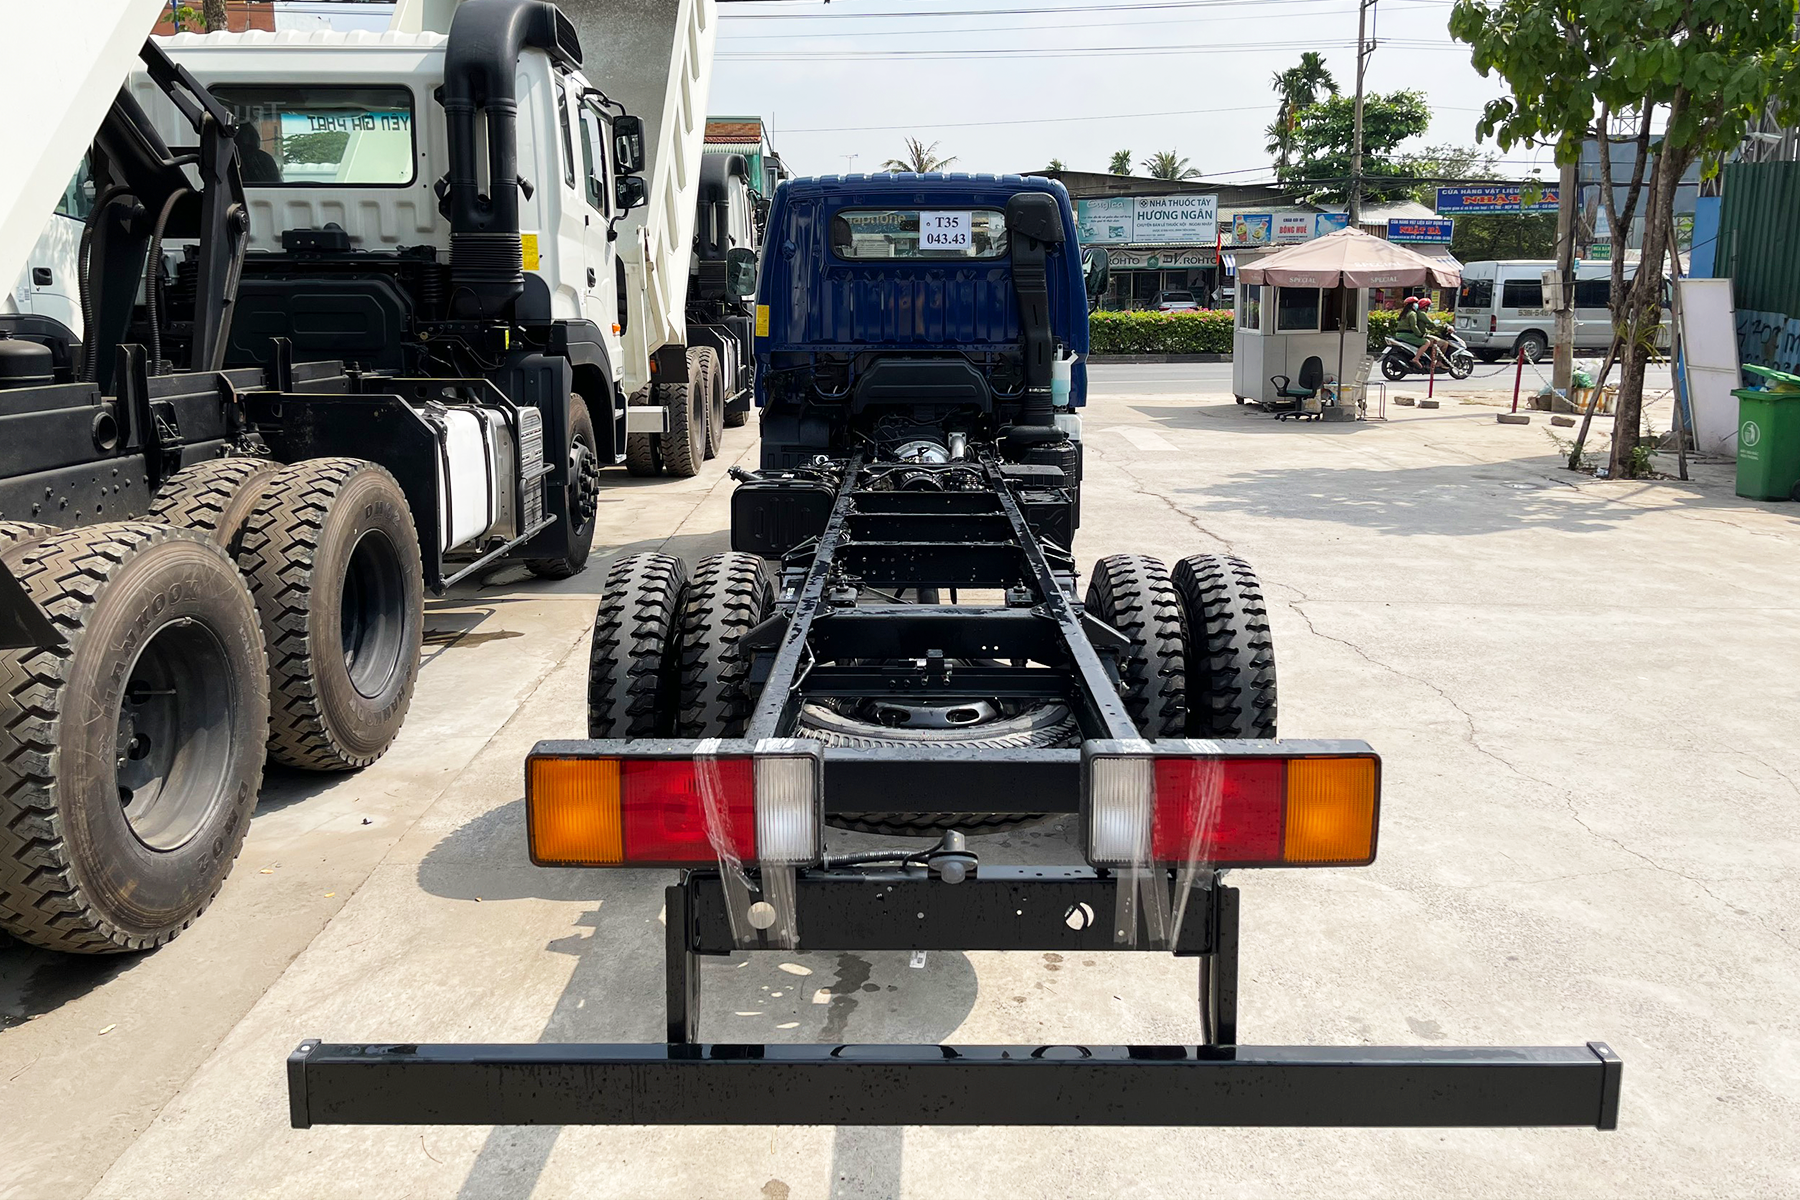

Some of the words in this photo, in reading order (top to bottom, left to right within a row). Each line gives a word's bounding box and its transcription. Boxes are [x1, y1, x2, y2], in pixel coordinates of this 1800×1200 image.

[1149, 198, 1167, 207] NHÀ
[1168, 197, 1195, 207] THUỐC
[1197, 198, 1212, 206] TÂY
[1137, 210, 1179, 220] HƯƠNG
[1180, 208, 1213, 219] NGÂN
[935, 217, 959, 228] T35
[927, 233, 966, 244] 043.43
